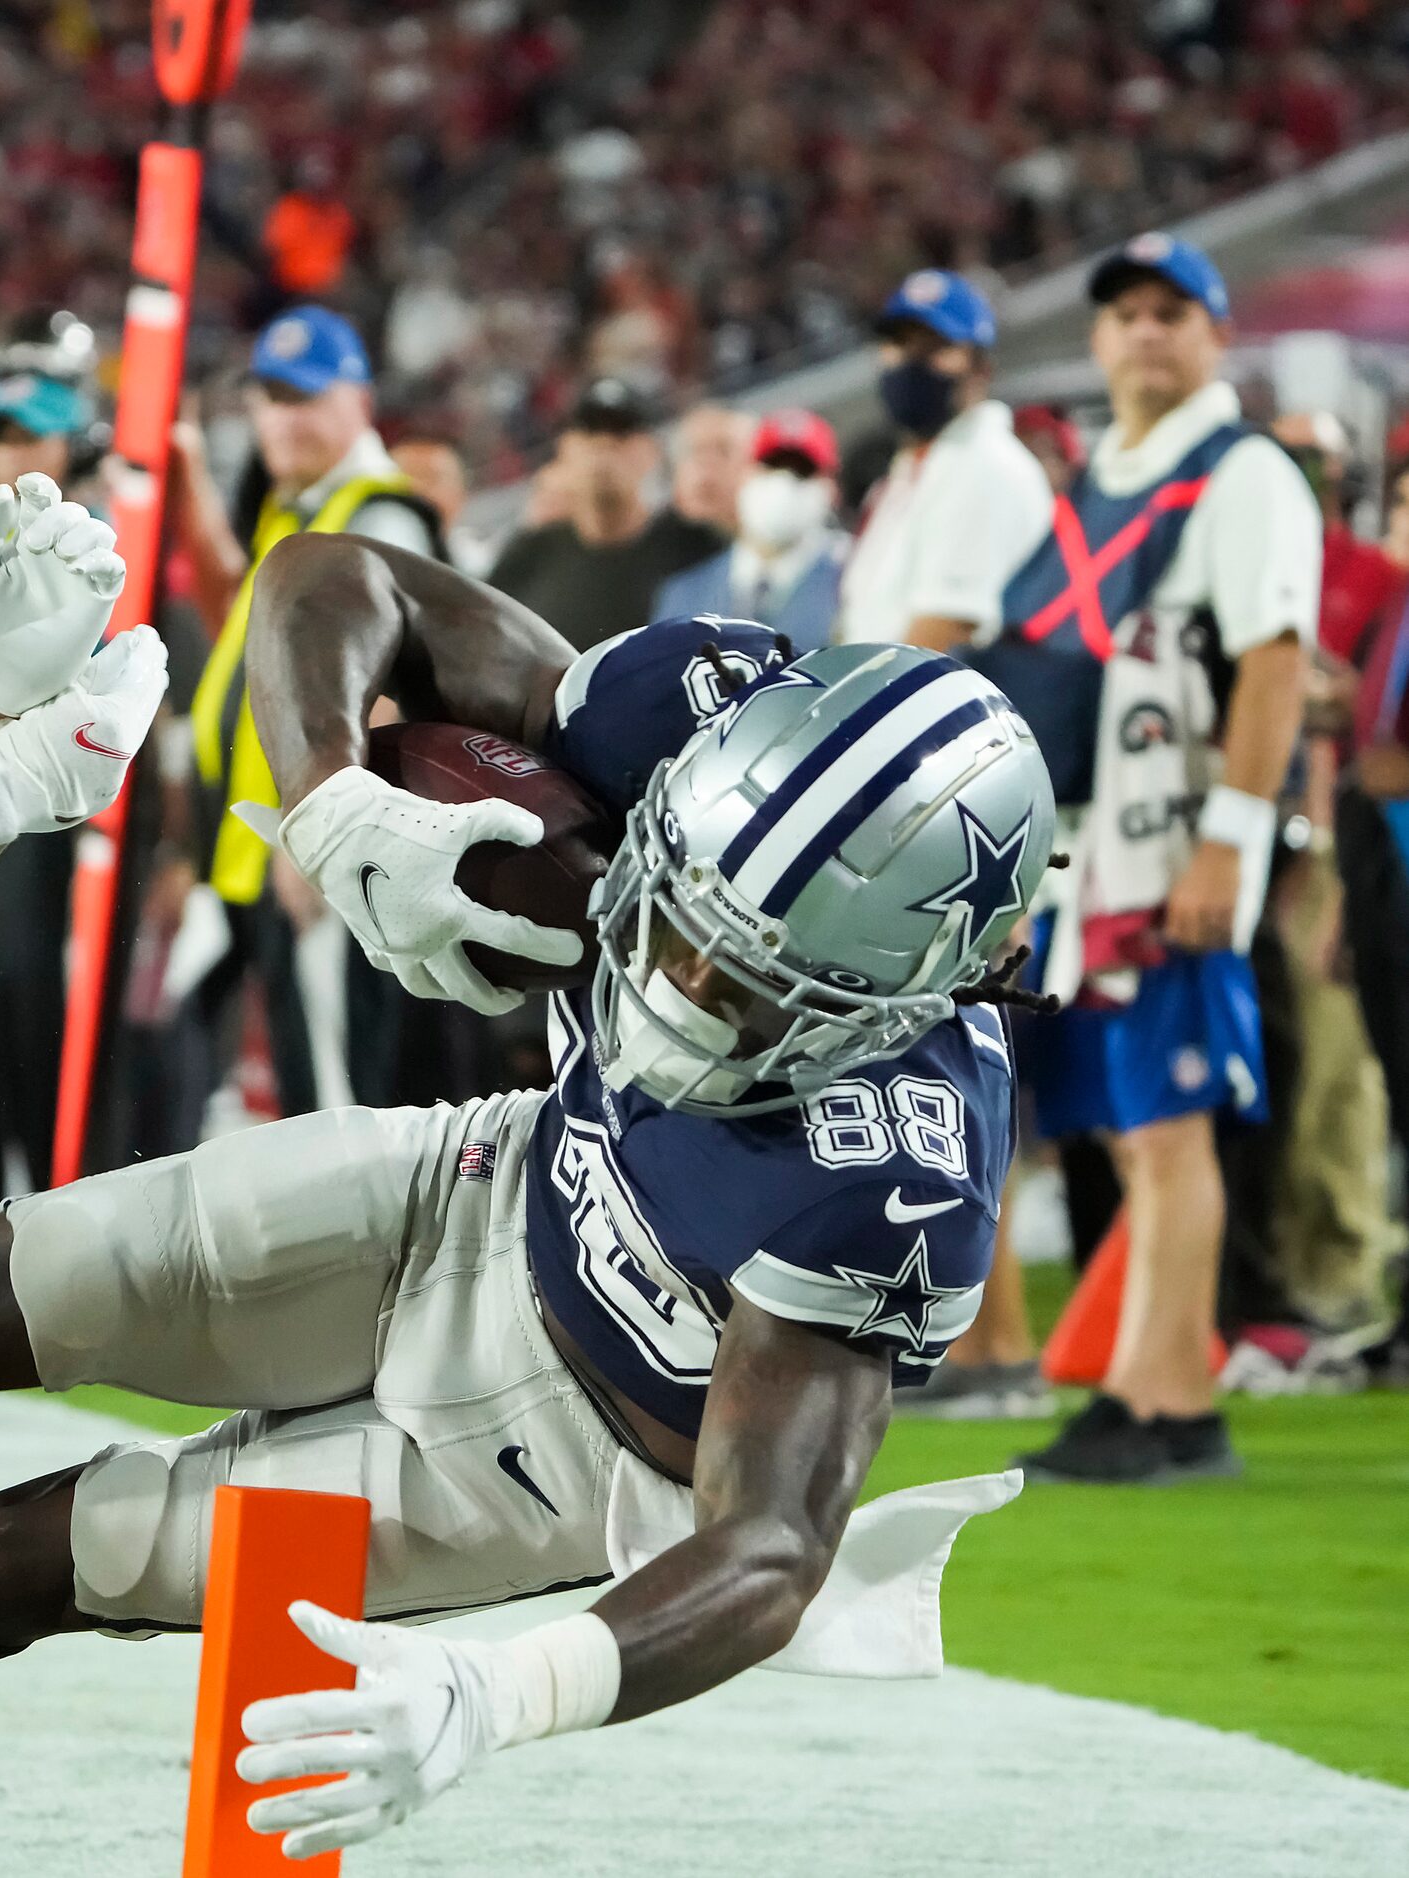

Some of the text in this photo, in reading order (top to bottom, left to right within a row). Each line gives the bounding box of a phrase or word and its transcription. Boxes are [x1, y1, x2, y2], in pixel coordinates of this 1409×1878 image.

[471, 739, 528, 772] NFL
[712, 886, 760, 931] COWBOYS
[798, 1073, 970, 1181] 88
[461, 1146, 483, 1173] NFL
